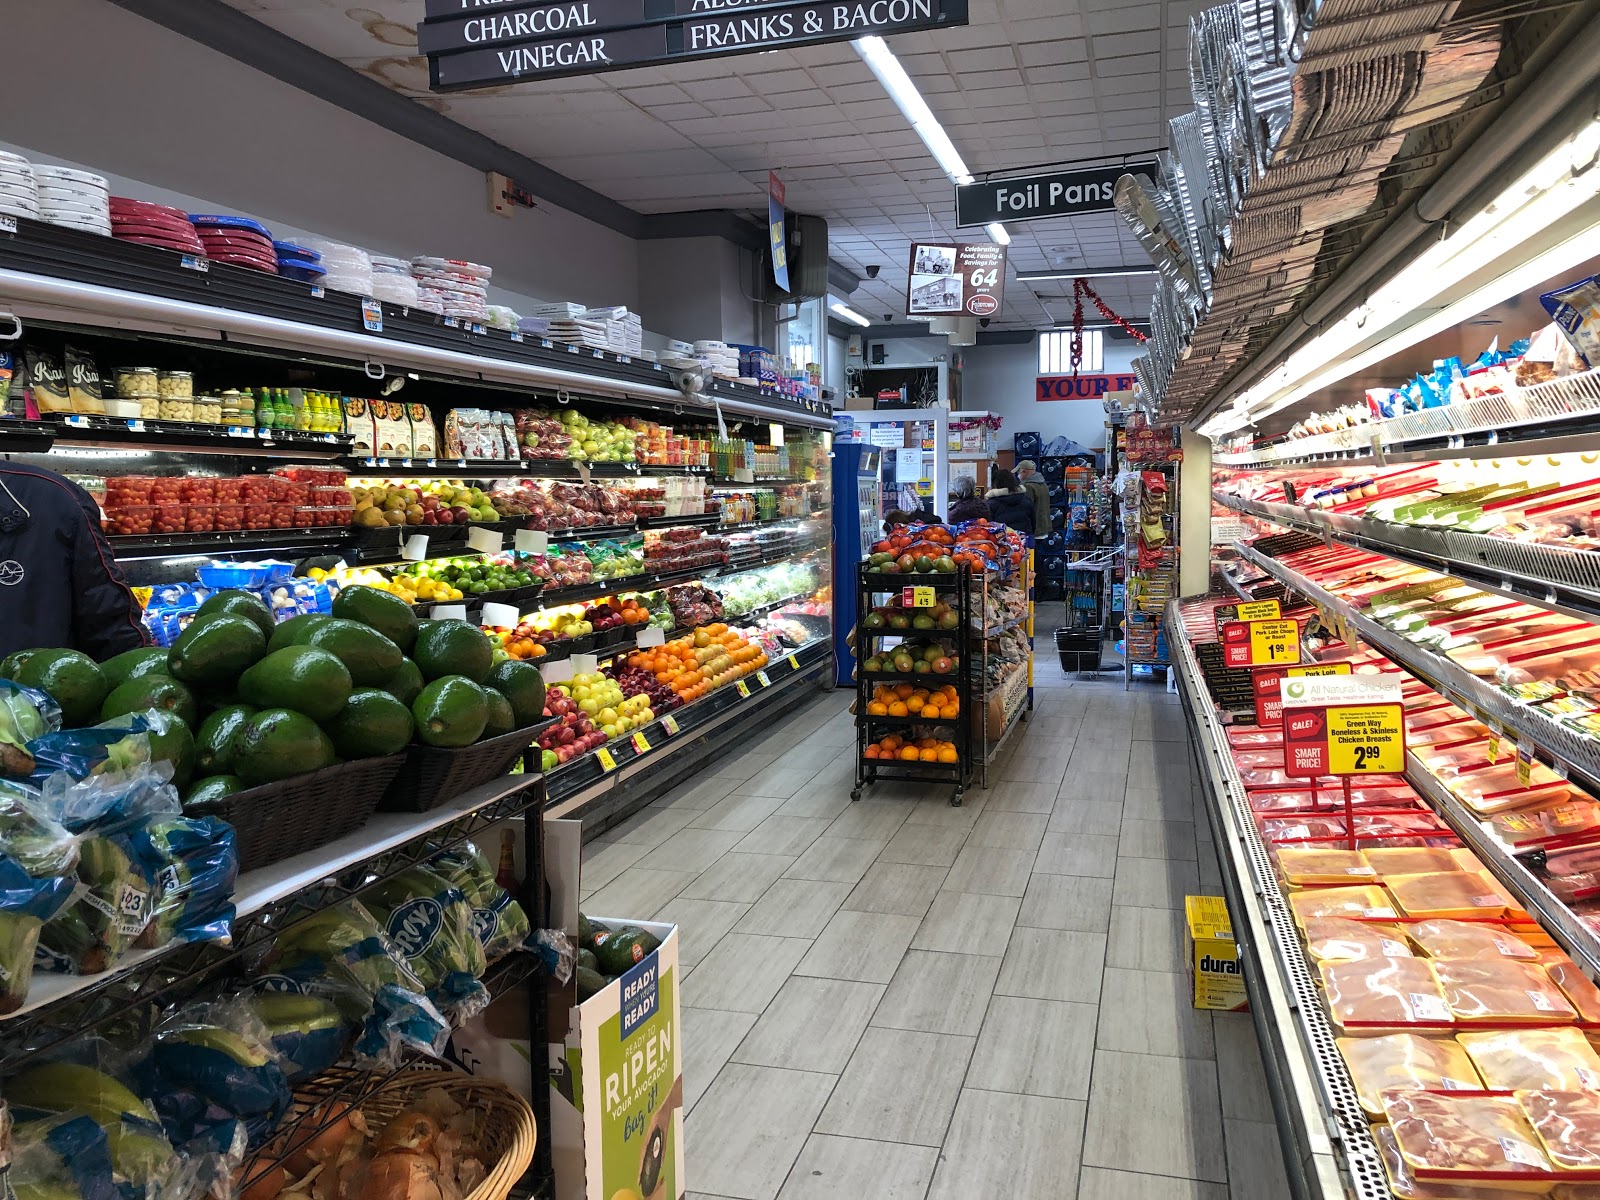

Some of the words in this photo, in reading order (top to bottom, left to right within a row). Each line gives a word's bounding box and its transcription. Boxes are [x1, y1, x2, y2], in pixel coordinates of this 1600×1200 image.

[464, 4, 596, 43] CHARCOAL
[691, 13, 794, 49] FRANKS
[803, 10, 823, 34] &
[833, 0, 932, 30] BACON
[497, 39, 608, 73] VINEGAR
[996, 186, 1039, 212] Foil
[1049, 181, 1114, 206] Pans
[971, 268, 998, 287] 64
[1038, 378, 1110, 398] YOUR
[1260, 678, 1278, 688] SALE!
[1310, 686, 1321, 694] All
[1323, 685, 1356, 694] Natural
[1359, 683, 1398, 693] Chicken
[1292, 720, 1313, 731] SALE!
[1346, 720, 1366, 728] Green
[1367, 720, 1382, 728] Way
[1370, 727, 1398, 735] Skinless
[1295, 748, 1322, 759] SMART
[1338, 736, 1365, 744] Chicken
[1296, 758, 1322, 769] PRICE!
[624, 966, 656, 1003] READY
[625, 998, 639, 1012] WHEN
[640, 981, 656, 1001] YOU'RE
[624, 992, 656, 1030] READY
[626, 1032, 646, 1058] READY
[647, 1024, 656, 1037] TO
[606, 1021, 671, 1113] RIPEN
[612, 1096, 632, 1121] YOUR
[634, 1060, 668, 1101] AVOCADO!
[624, 1110, 646, 1143] Bag
[648, 1083, 658, 1114] it!
